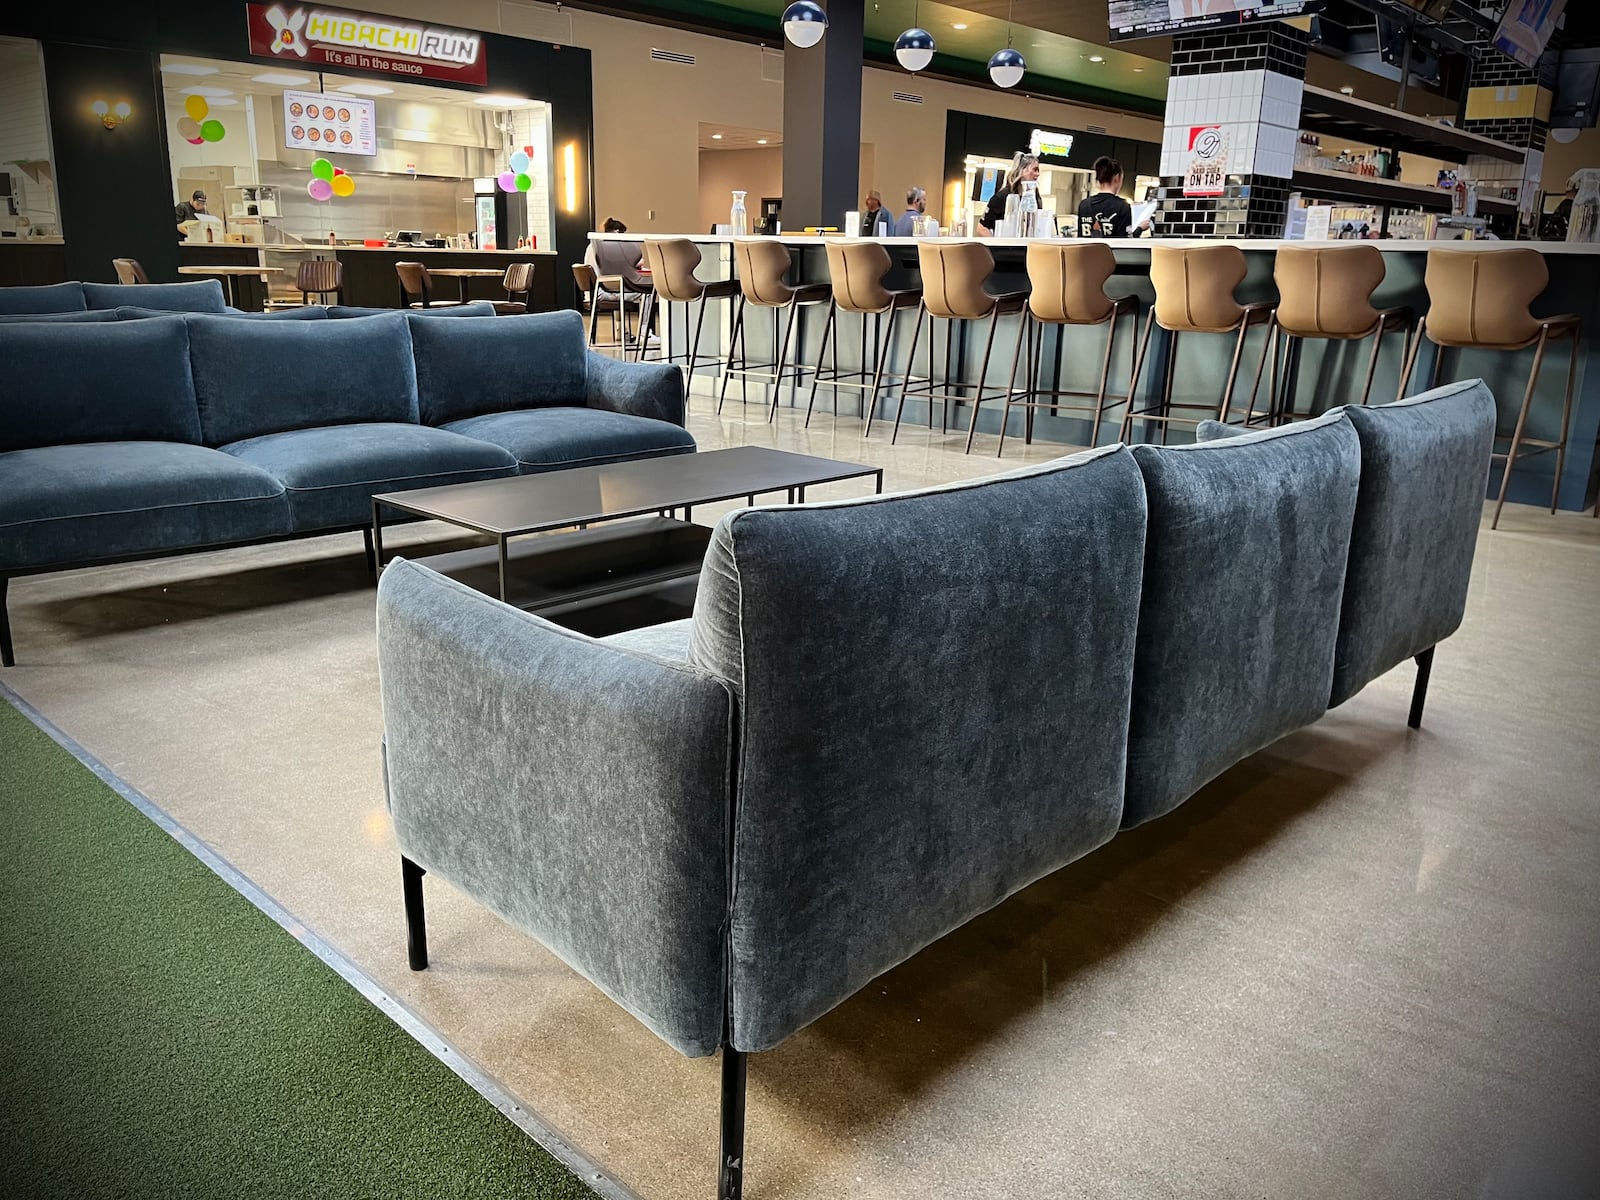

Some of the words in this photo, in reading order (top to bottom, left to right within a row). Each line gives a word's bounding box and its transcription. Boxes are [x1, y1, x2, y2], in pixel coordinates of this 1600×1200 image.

[308, 16, 418, 51] HIBACHI
[425, 35, 474, 60] RUN
[325, 50, 342, 63] It's
[344, 54, 358, 66] all
[360, 57, 370, 68] in
[372, 58, 390, 71] the
[391, 62, 423, 75] sauce
[1190, 174, 1202, 186] ON
[1205, 173, 1221, 186] TAP
